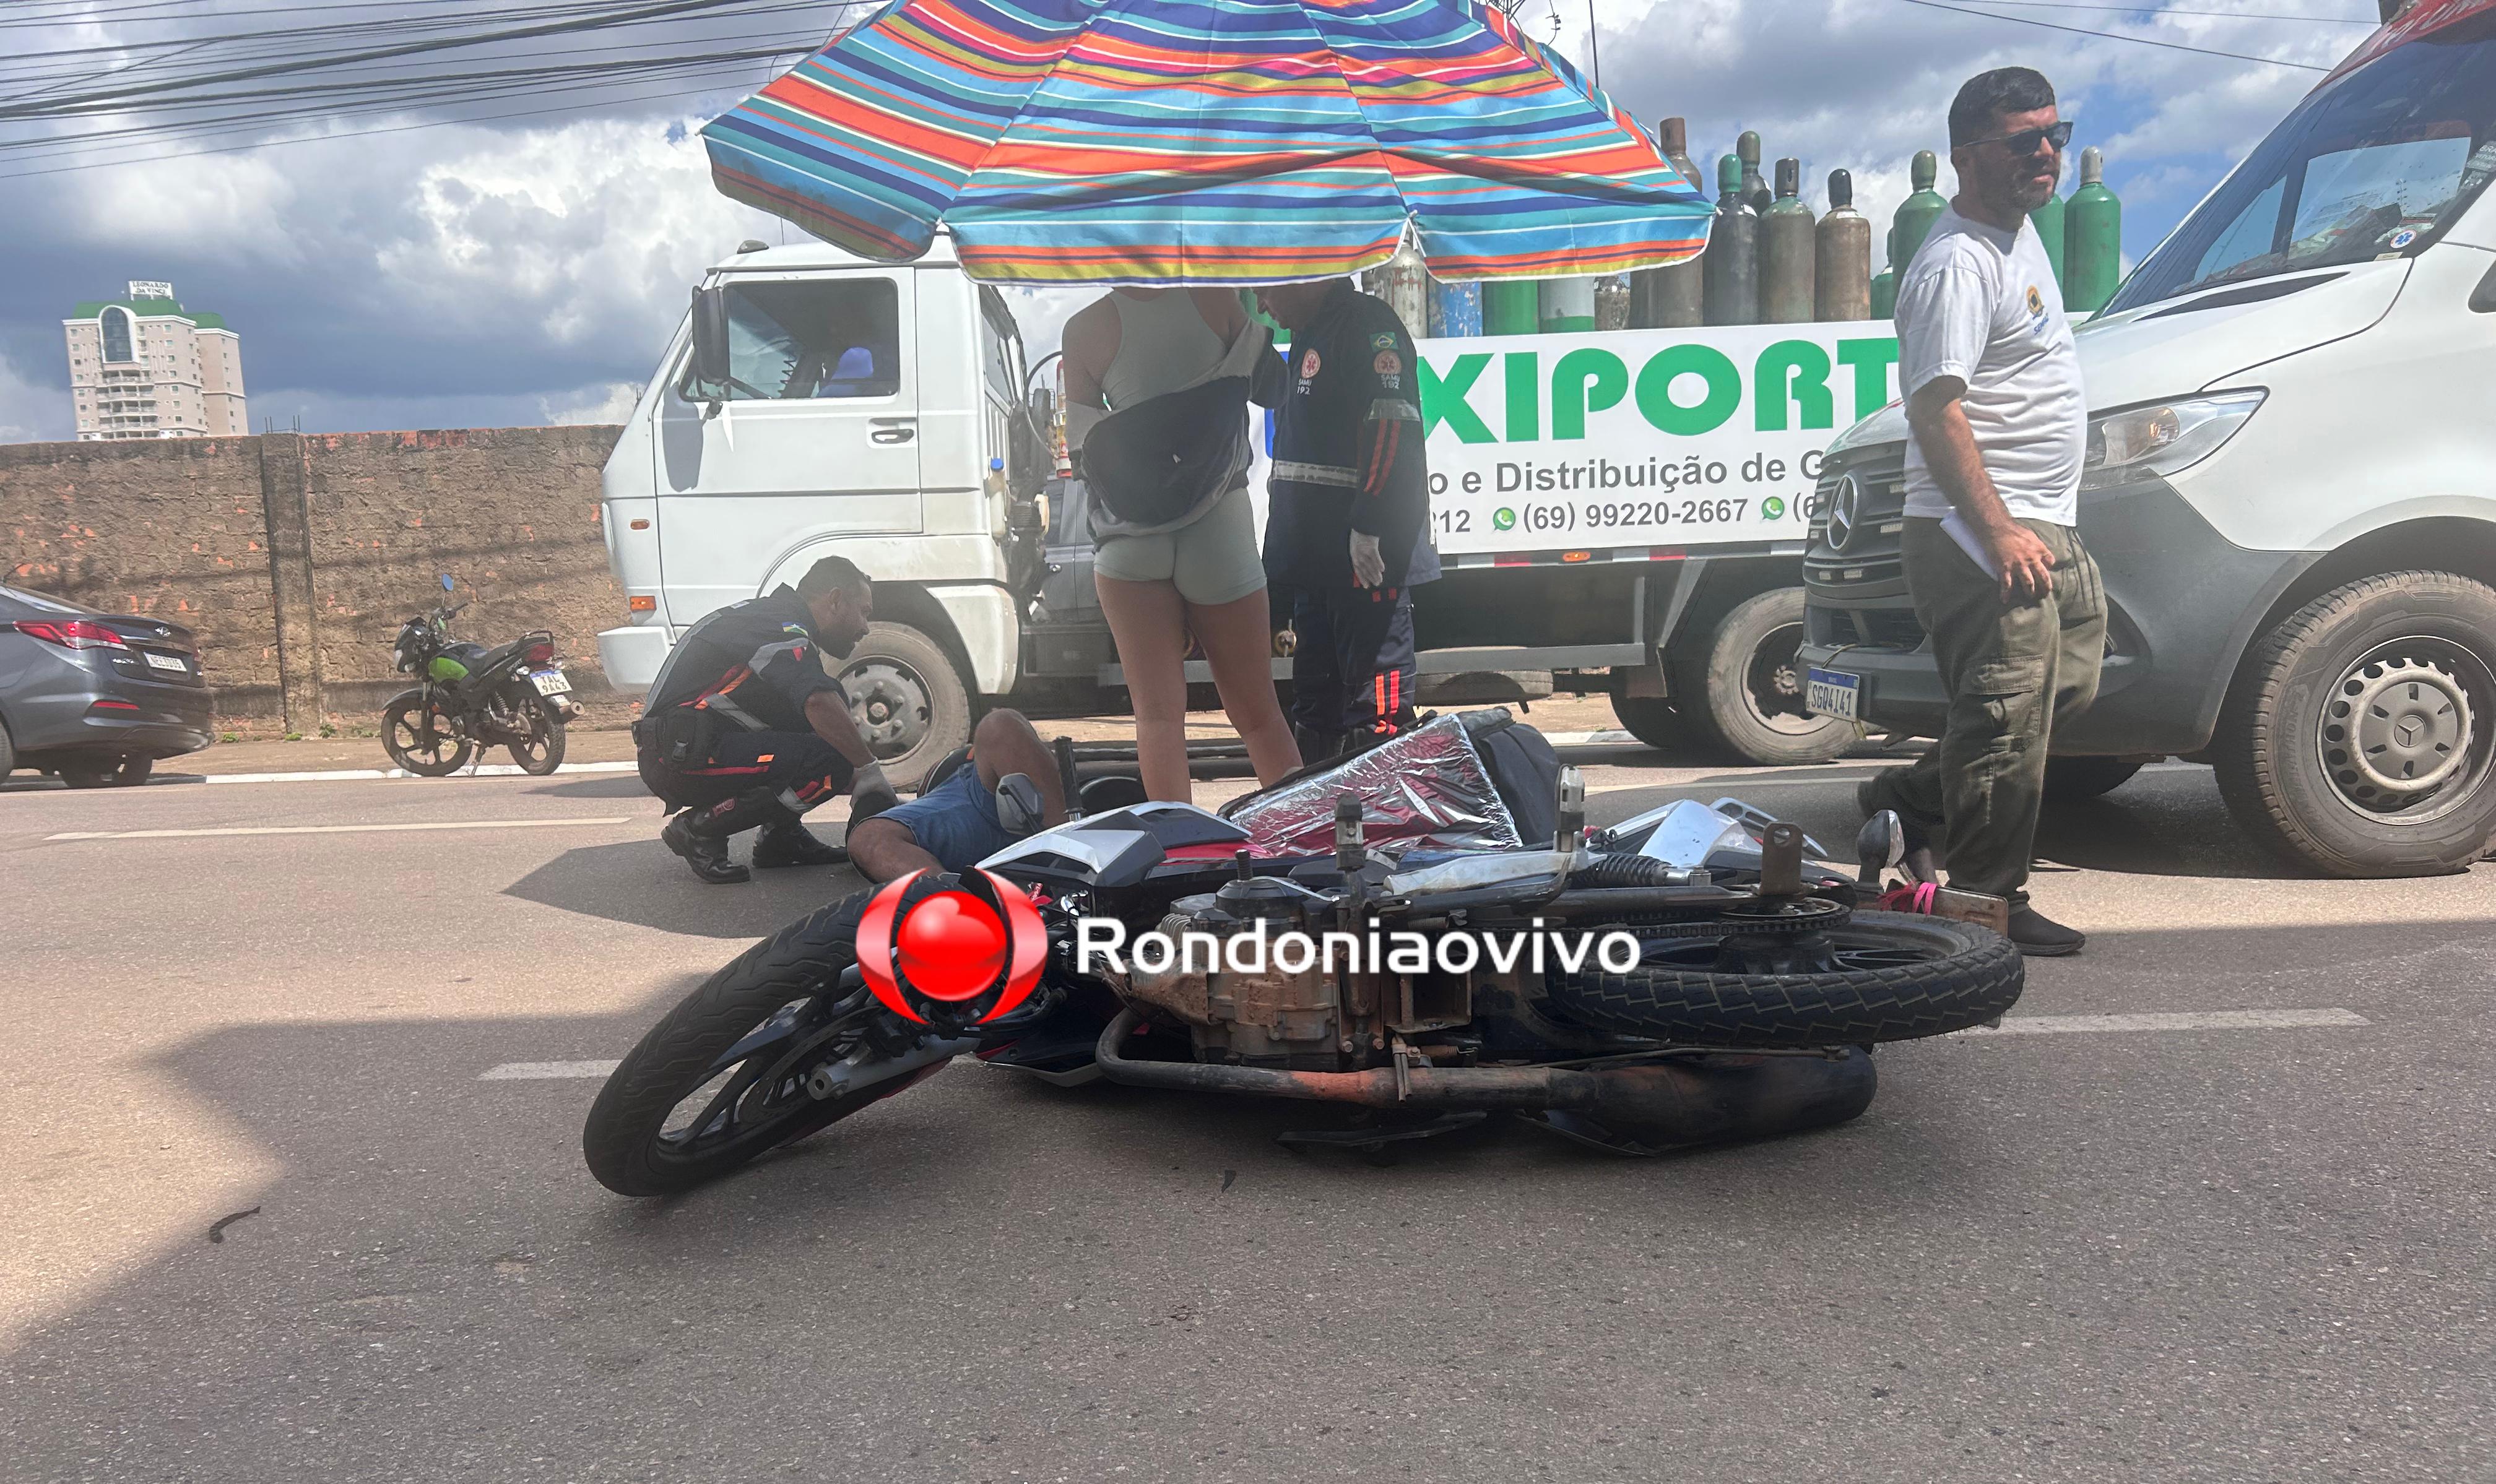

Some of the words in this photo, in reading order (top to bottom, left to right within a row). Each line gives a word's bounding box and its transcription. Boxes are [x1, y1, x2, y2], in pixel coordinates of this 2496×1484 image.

[1298, 378, 1312, 386] SAMU
[1380, 374, 1400, 382] SAMU
[1382, 381, 1399, 390] 192
[1297, 386, 1311, 395] 192
[1461, 471, 1481, 494] e
[1496, 454, 1727, 494] Distribuição
[1741, 452, 1786, 483] de
[1432, 509, 1471, 533] 12
[1523, 501, 1576, 533] (69)
[1585, 498, 1748, 528] 99220-2667
[542, 681, 567, 693] 9A43
